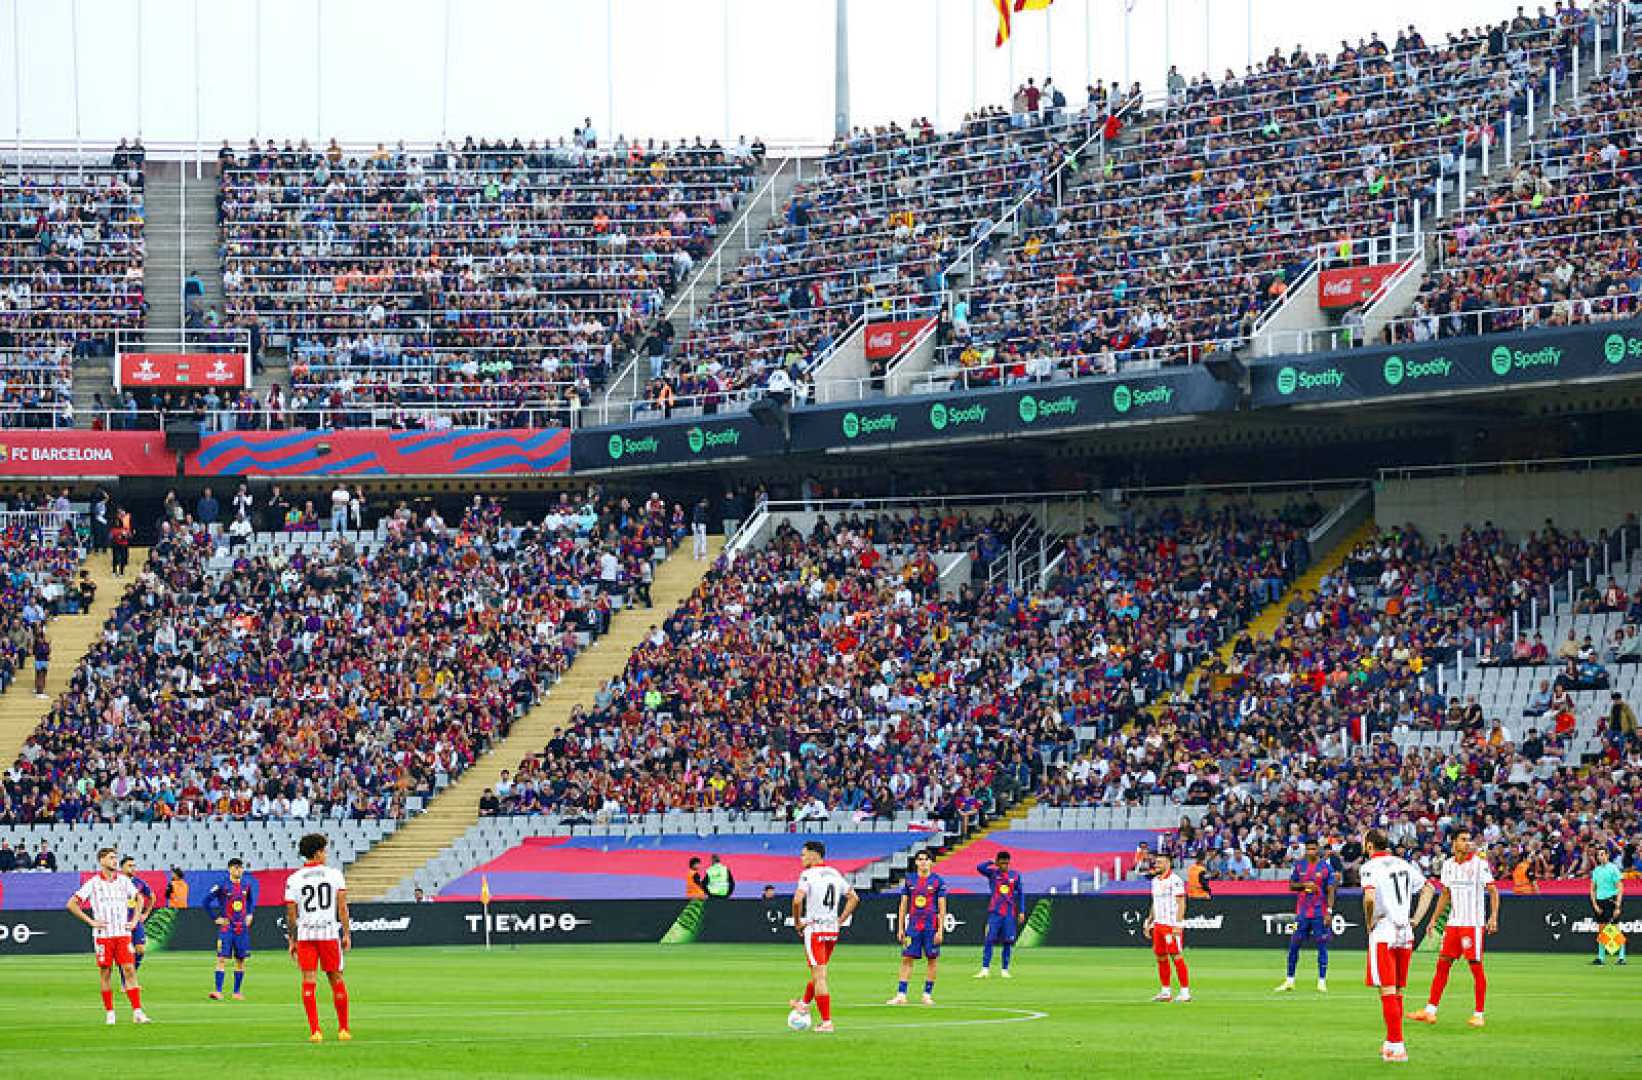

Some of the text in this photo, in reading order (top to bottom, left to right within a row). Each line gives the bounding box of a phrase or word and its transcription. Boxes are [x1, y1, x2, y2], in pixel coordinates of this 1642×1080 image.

[1406, 357, 1452, 378] Spotify
[1299, 369, 1344, 388] Spotify
[11, 446, 114, 461] FC BARCELONA
[301, 882, 331, 912] 20
[822, 884, 836, 911] 4
[1389, 870, 1409, 905] 17
[465, 913, 577, 933] TIEMPO
